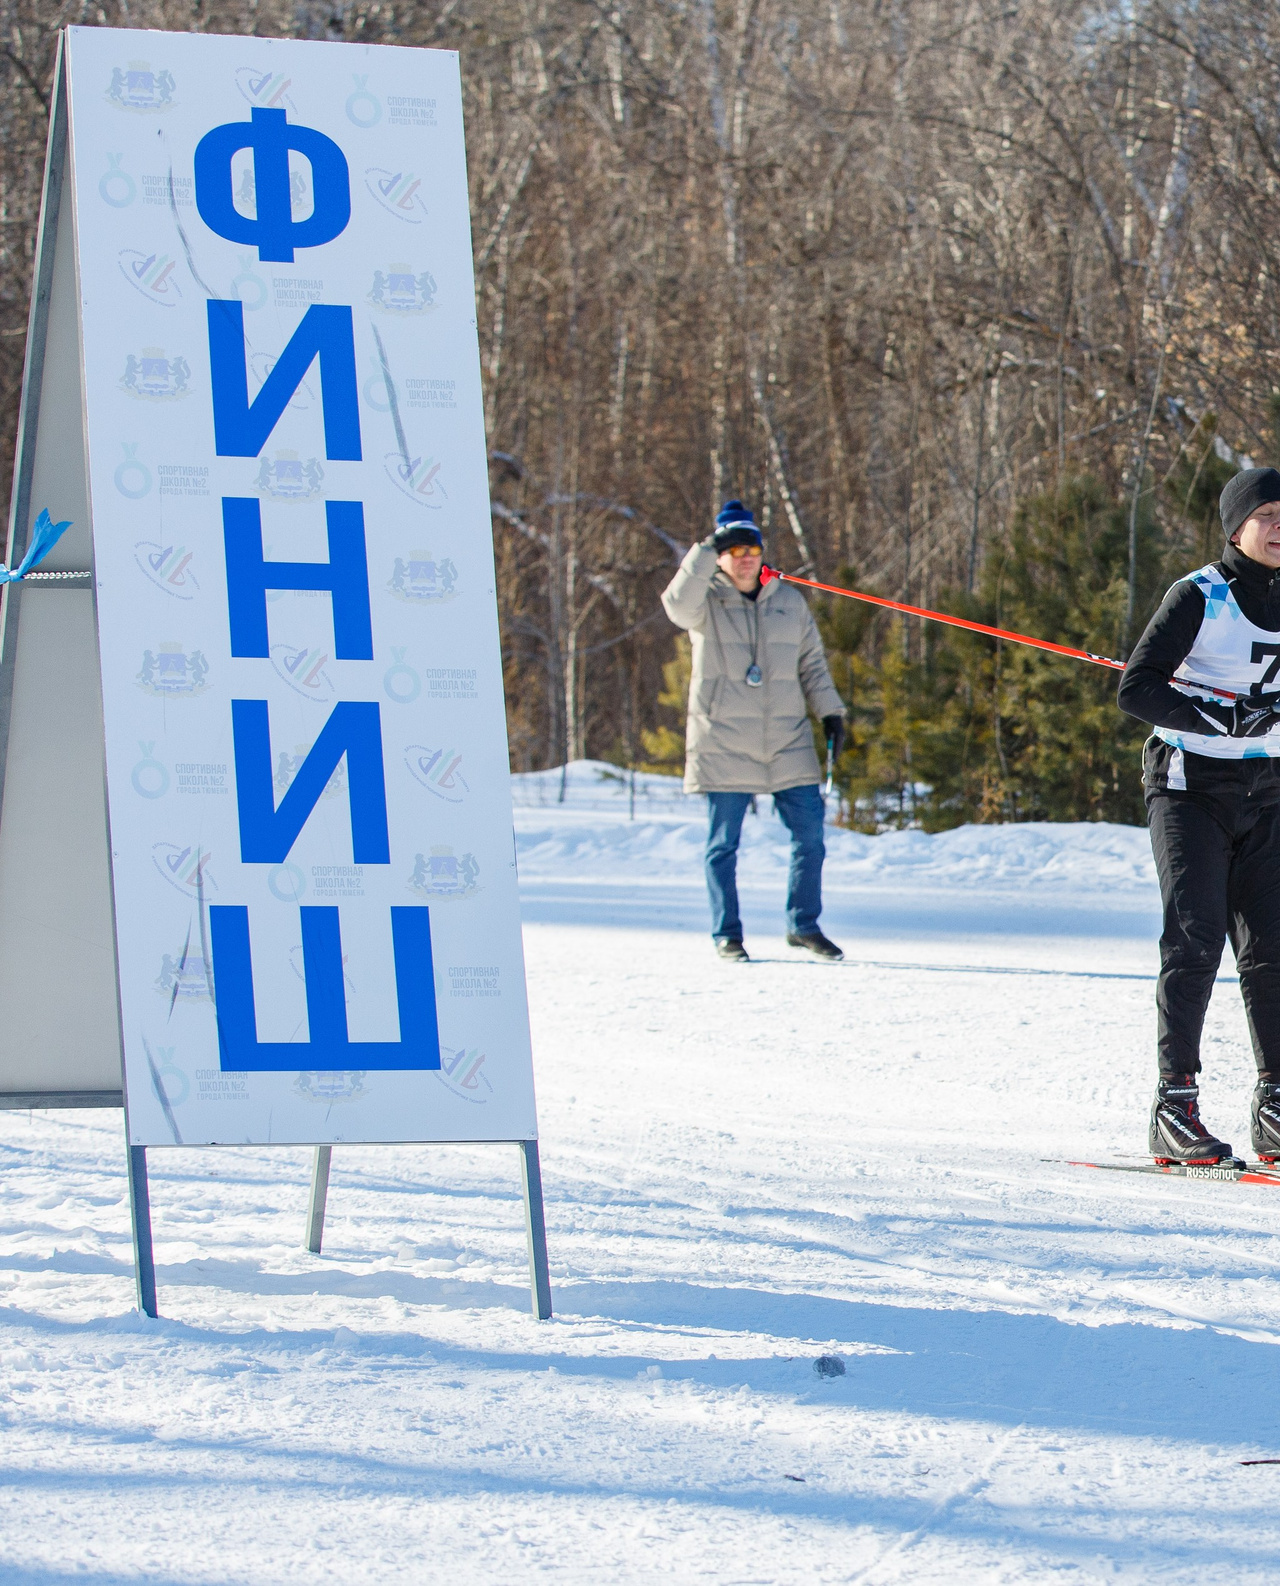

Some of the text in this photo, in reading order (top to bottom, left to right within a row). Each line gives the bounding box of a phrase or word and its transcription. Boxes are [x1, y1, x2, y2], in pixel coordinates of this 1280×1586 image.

[387, 96, 437, 108] СПОРТИВНАЯ
[390, 107, 434, 119] ШКОЛА №2
[175, 187, 190, 198] №2
[273, 278, 323, 289] СПОРТИВНАЯ
[276, 289, 321, 300] ШКОЛА №2
[405, 378, 456, 390] СПОРТИВНАЯ
[409, 389, 453, 401] ШКОЛА №2
[158, 465, 209, 477] СПОРТИВНАЯ
[160, 476, 206, 488] ШКОЛА №2
[194, 107, 441, 1072] ФИНИШ
[426, 668, 477, 680] СПОРТИВНАЯ
[429, 679, 474, 691] ШКОЛА №2
[175, 763, 227, 775] СПОРТИВНАЯ
[178, 775, 225, 787] ШКОЛА №2
[311, 865, 363, 877] СПОРТИВНАЯ
[314, 877, 361, 889] ШКОЛА №2
[448, 966, 500, 977] СПОРТИВНАЯ
[452, 978, 498, 989] ШКОЛА №2
[198, 1081, 246, 1091] ШКОЛА №2
[1186, 1167, 1237, 1180] ROSSIGNOL
